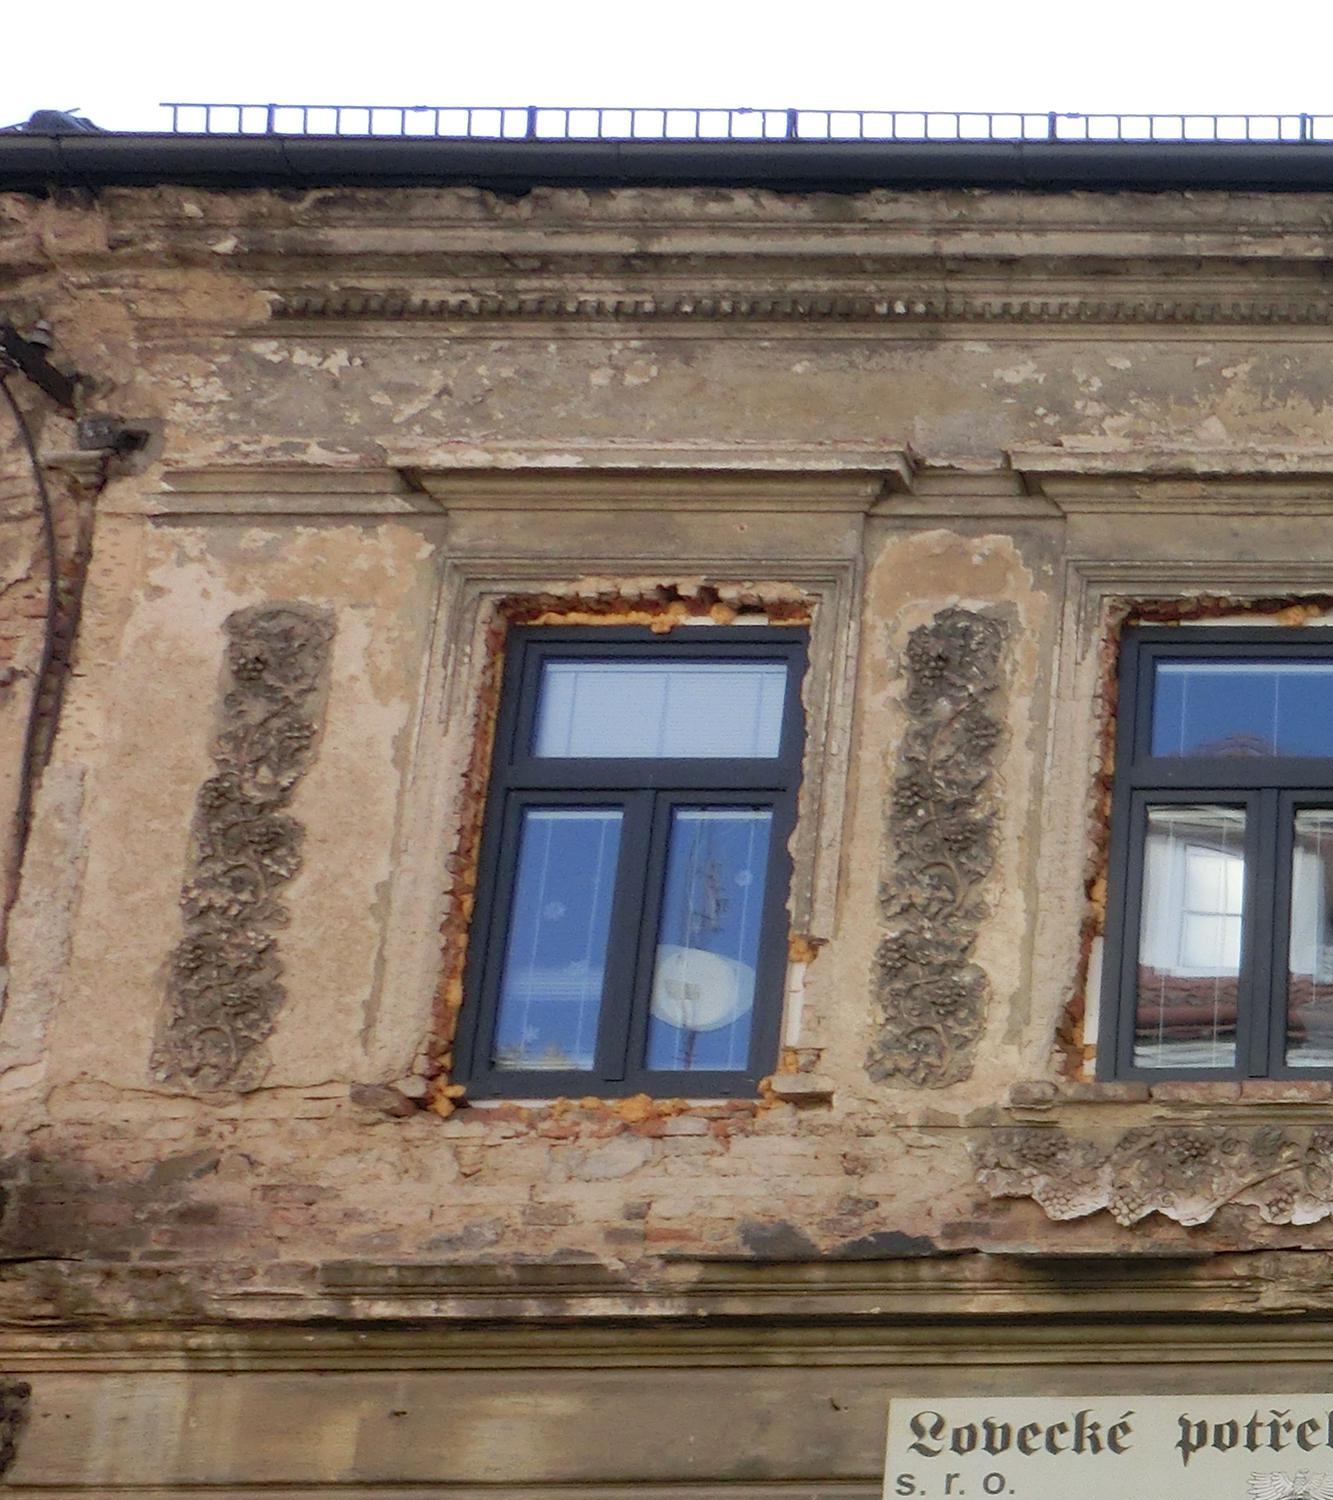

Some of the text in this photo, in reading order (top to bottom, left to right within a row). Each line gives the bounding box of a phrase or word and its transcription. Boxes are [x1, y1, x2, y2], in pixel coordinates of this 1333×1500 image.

[906, 1409, 1136, 1458] Lovecké
[896, 1472, 1015, 1496] s. r. o.
